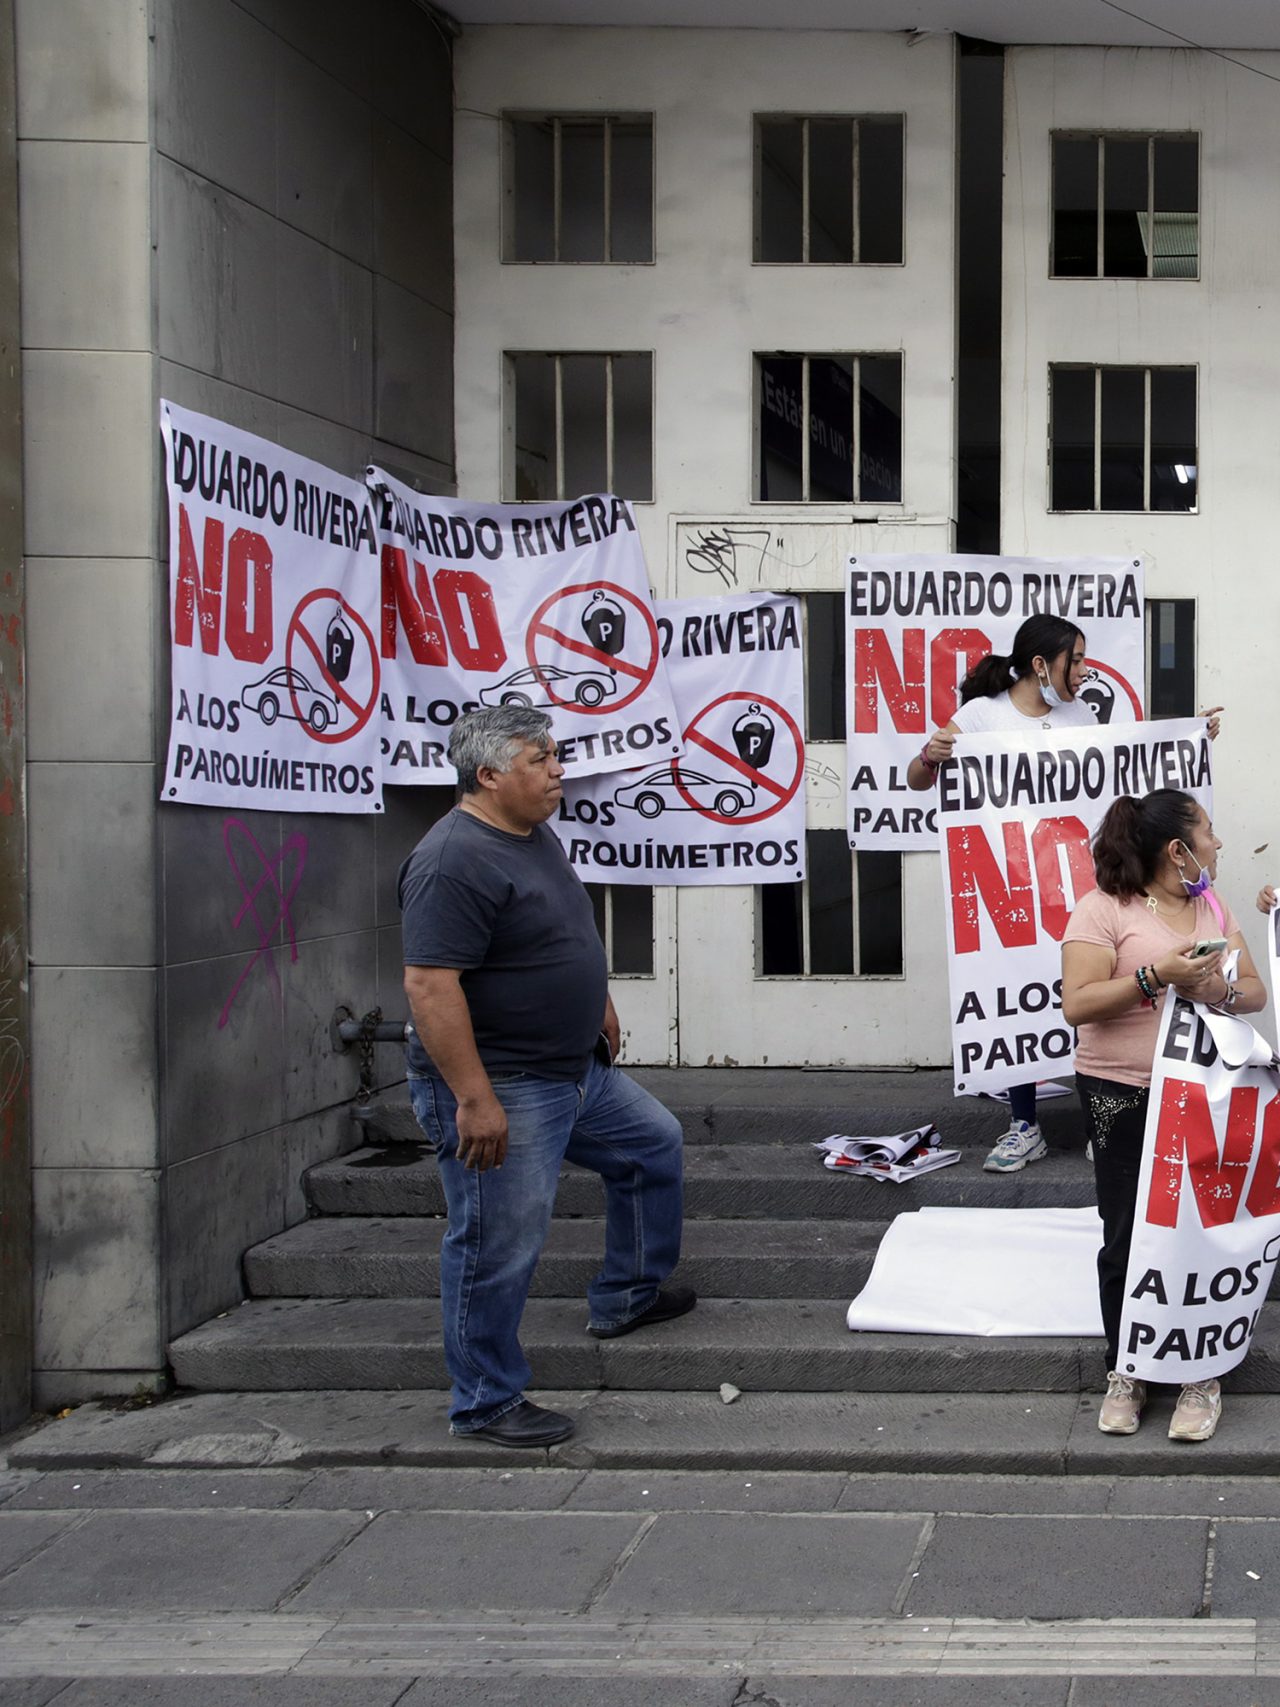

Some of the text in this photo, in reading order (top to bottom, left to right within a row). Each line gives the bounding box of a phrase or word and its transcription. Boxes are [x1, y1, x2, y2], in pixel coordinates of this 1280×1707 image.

[293, 478, 378, 555] RIVERA
[513, 499, 636, 559] RIVERA
[175, 503, 273, 664] NO
[381, 543, 507, 672] NO
[850, 571, 1141, 618] EDUARDO RIVERA
[682, 606, 800, 658] RIVERA
[854, 628, 993, 734] NO
[176, 689, 241, 733] A LOS
[173, 744, 374, 795] PARQUÍMETROS
[851, 765, 879, 791] A
[940, 738, 1212, 812] EDUARDO RIVERA
[569, 838, 799, 870] RQUÍMETROS
[946, 815, 1096, 954] NO
[955, 991, 986, 1024] A
[1130, 1260, 1262, 1306] A LOS
